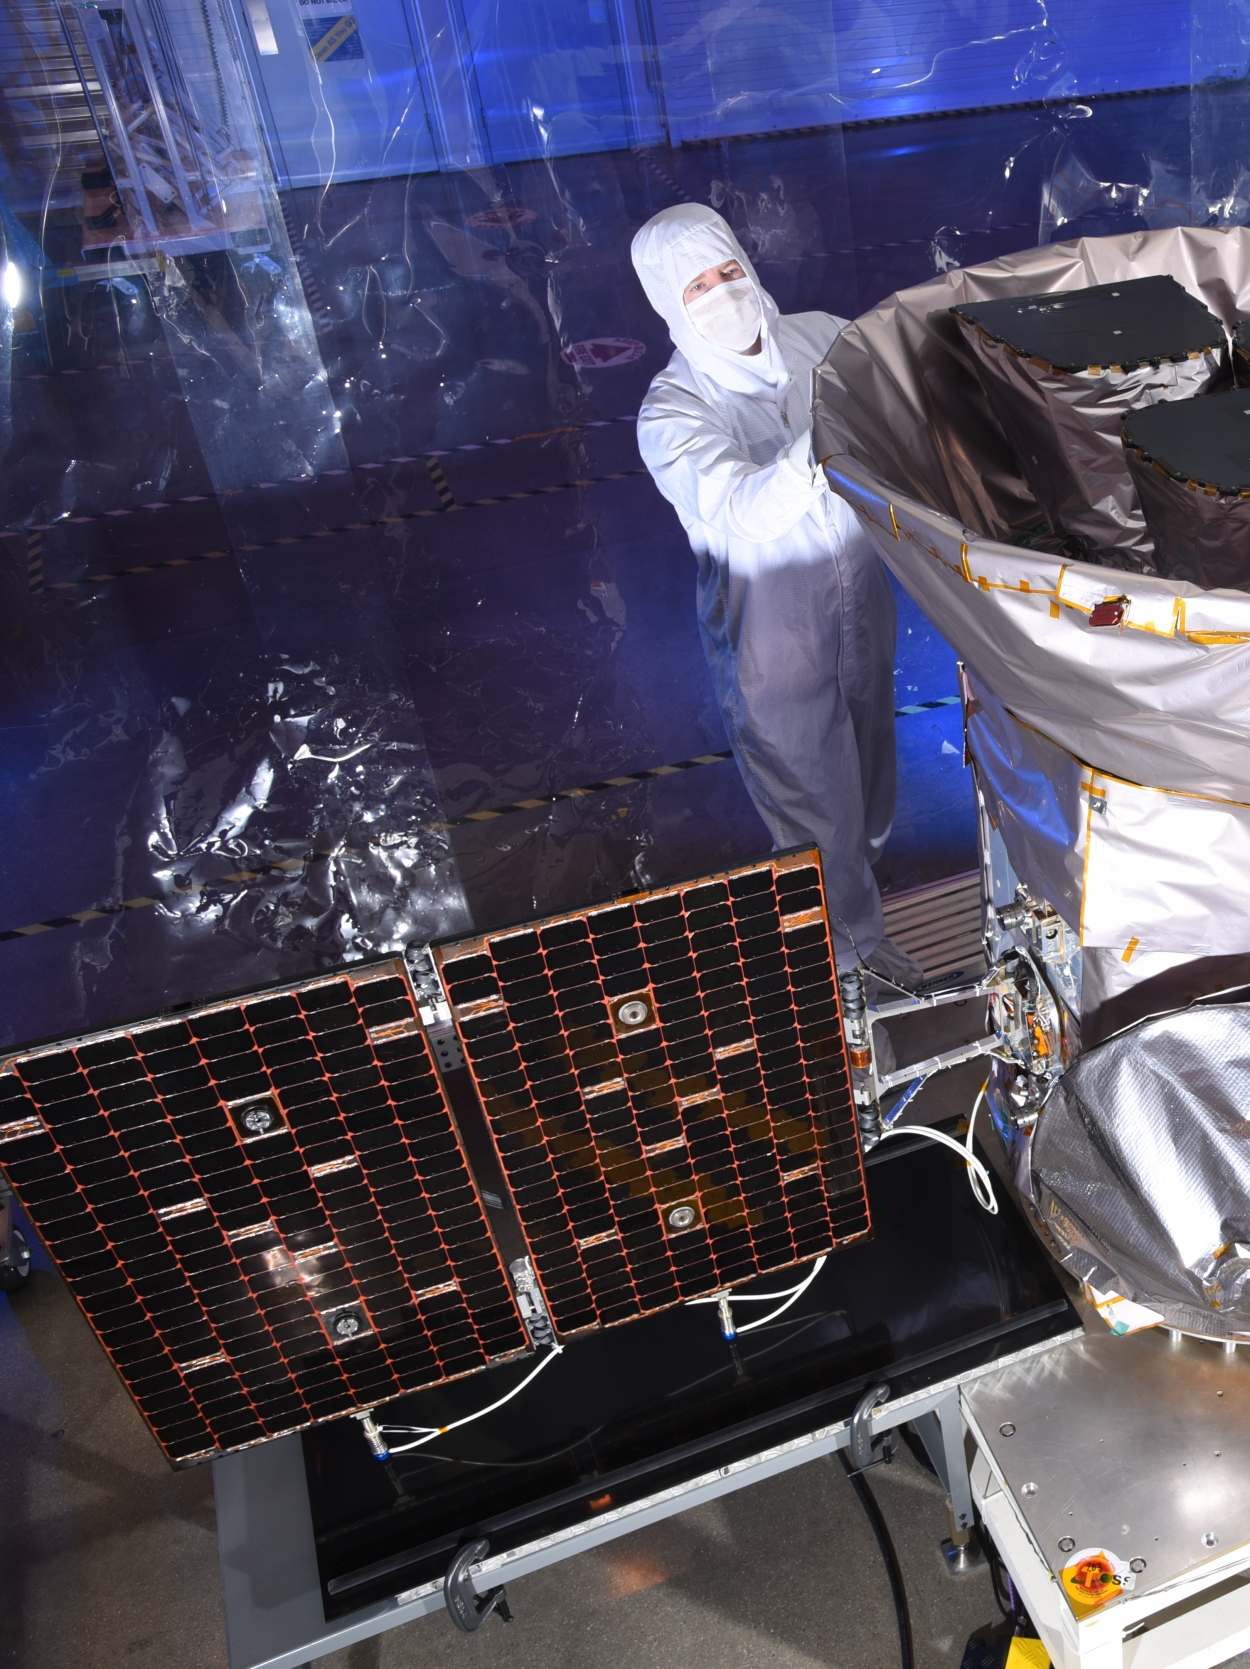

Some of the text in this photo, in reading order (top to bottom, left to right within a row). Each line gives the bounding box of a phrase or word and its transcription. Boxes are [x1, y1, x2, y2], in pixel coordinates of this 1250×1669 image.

[326, 36, 337, 46] AS
[334, 28, 347, 38] You
[921, 974, 955, 990] WERNER
